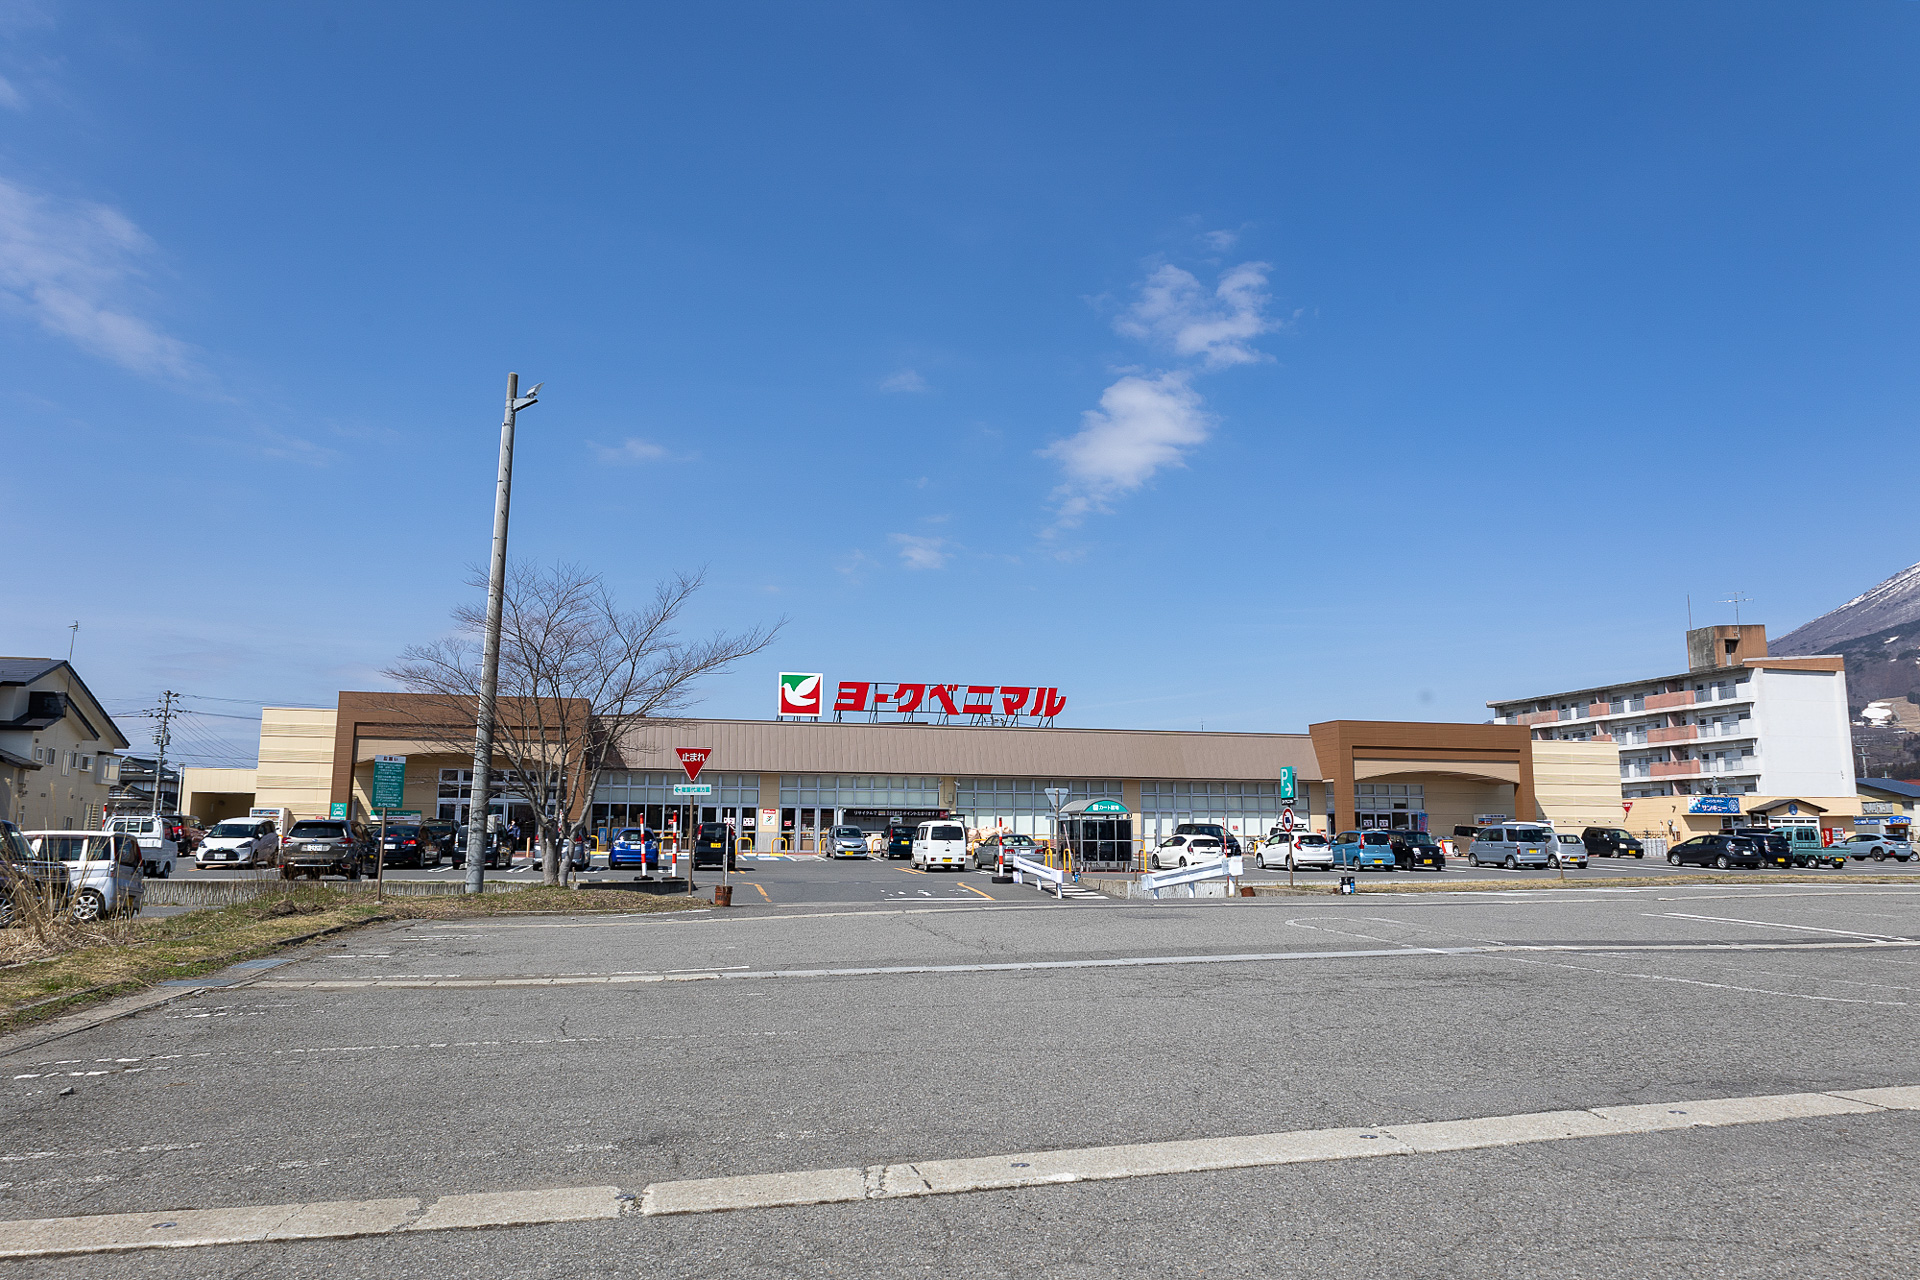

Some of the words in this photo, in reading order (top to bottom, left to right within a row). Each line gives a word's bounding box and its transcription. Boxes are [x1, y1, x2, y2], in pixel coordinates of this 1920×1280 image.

[833, 681, 1067, 717] ヨークベニマル
[681, 752, 706, 762] 止まれ
[1280, 768, 1288, 786] P
